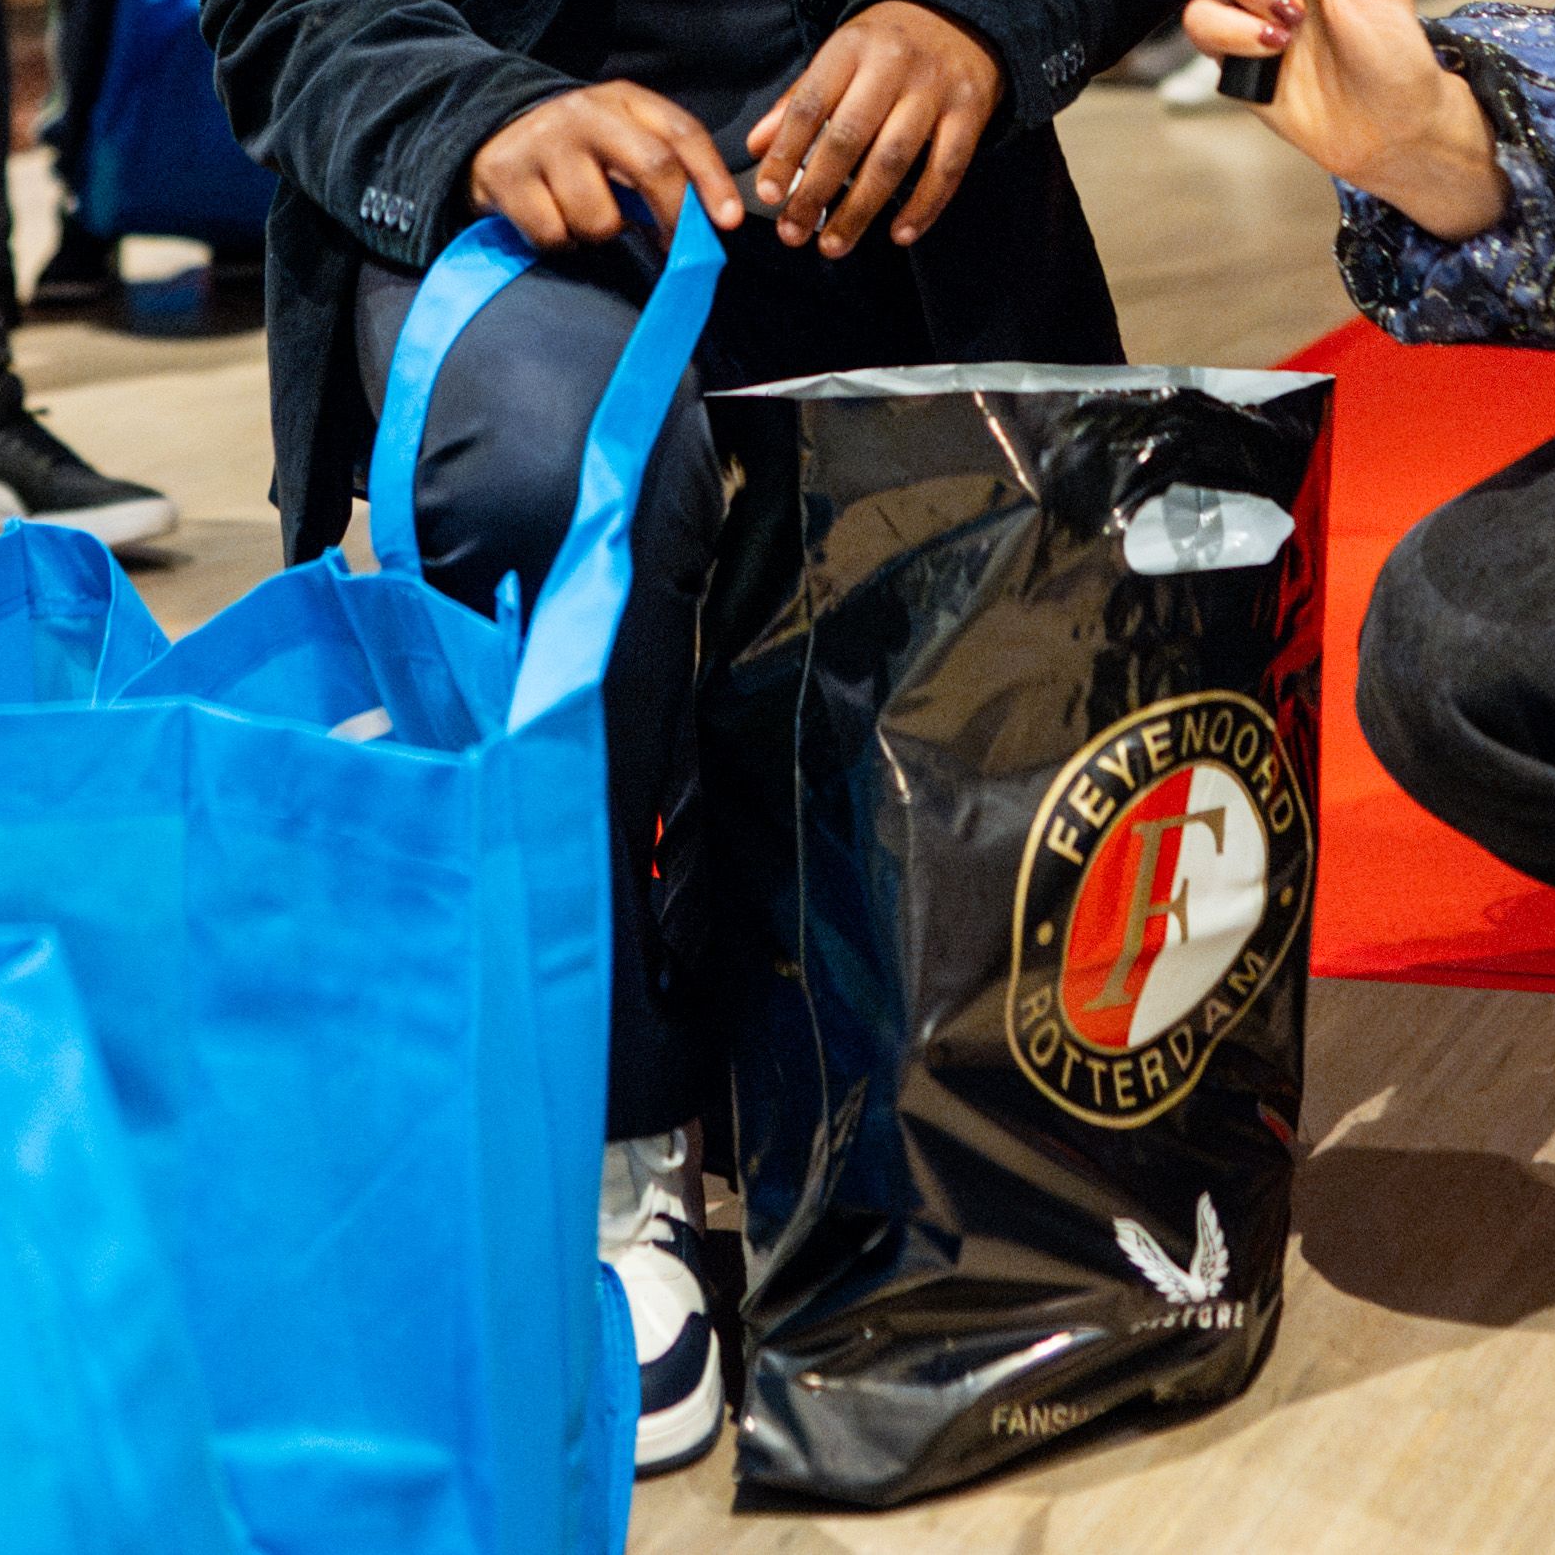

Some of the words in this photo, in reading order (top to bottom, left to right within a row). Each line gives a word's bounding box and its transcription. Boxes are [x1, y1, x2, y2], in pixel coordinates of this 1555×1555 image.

[1046, 708, 1296, 867] FEYENOORD
[1081, 805, 1227, 1013] F
[1019, 952, 1268, 1111] ROTTERDAM
